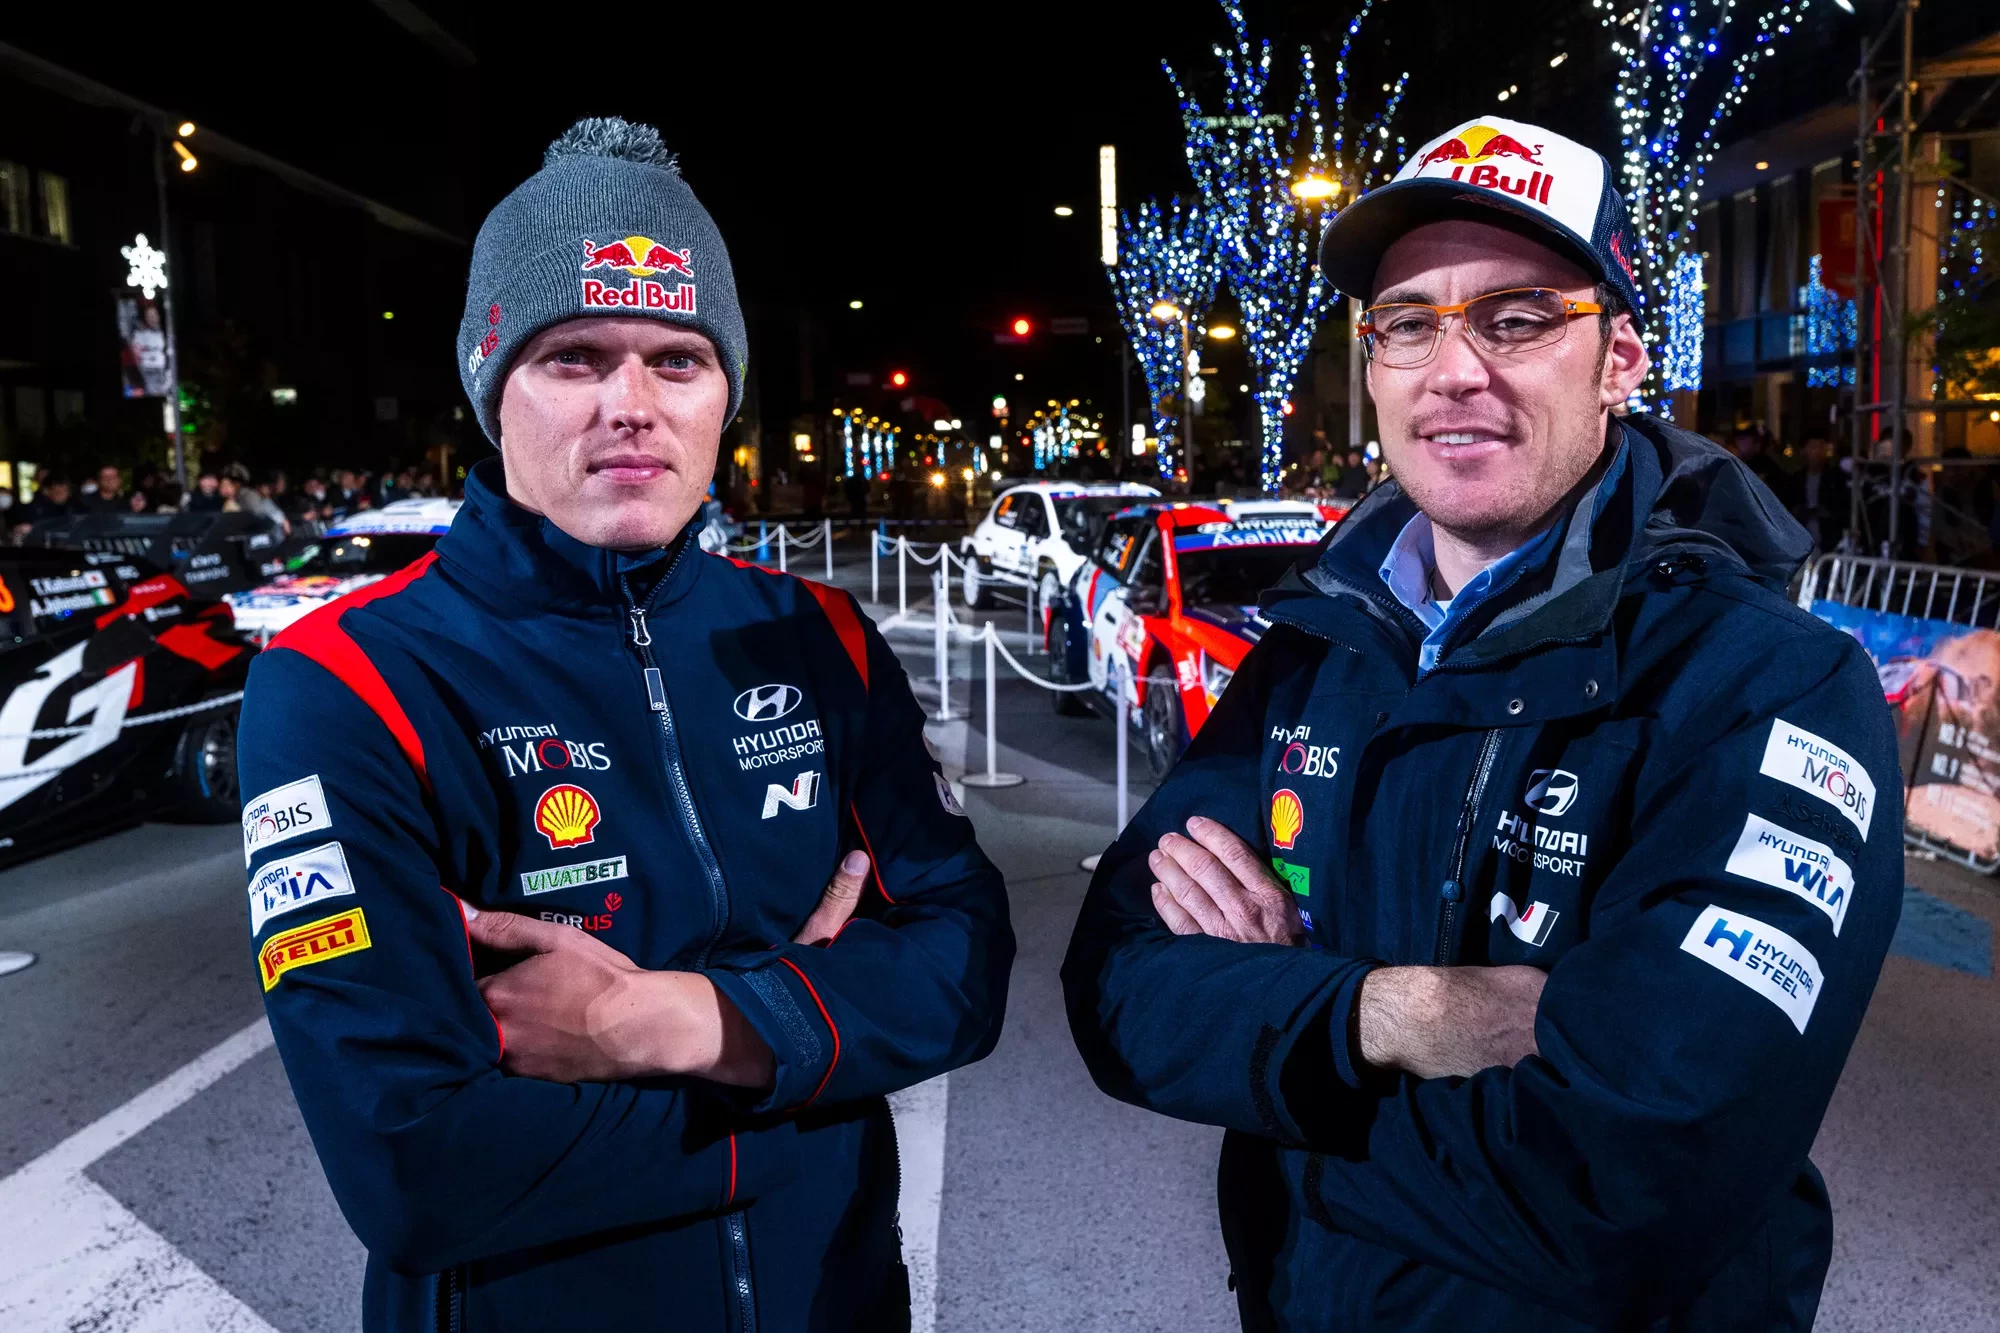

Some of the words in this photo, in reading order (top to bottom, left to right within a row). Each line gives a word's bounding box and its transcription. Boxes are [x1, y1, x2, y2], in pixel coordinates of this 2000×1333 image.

[1469, 165, 1554, 205] Bull
[584, 280, 639, 306] Red
[645, 282, 694, 312] Bull
[469, 329, 499, 374] ORUS
[733, 719, 823, 755] HYUNDAI
[739, 739, 825, 771] MOTORSPORT
[1788, 735, 1850, 774] HYUNDAI
[502, 739, 611, 777] MOBIS
[1278, 742, 1340, 778] OBIS
[1802, 756, 1867, 821] MOBIS
[1758, 831, 1830, 871] HYUNDAI
[263, 872, 335, 912] WIA
[527, 860, 623, 891] VIVATBET
[1785, 858, 1845, 915] WIA
[1745, 955, 1797, 999] STEEL
[1754, 939, 1814, 995] HYUNDAI
